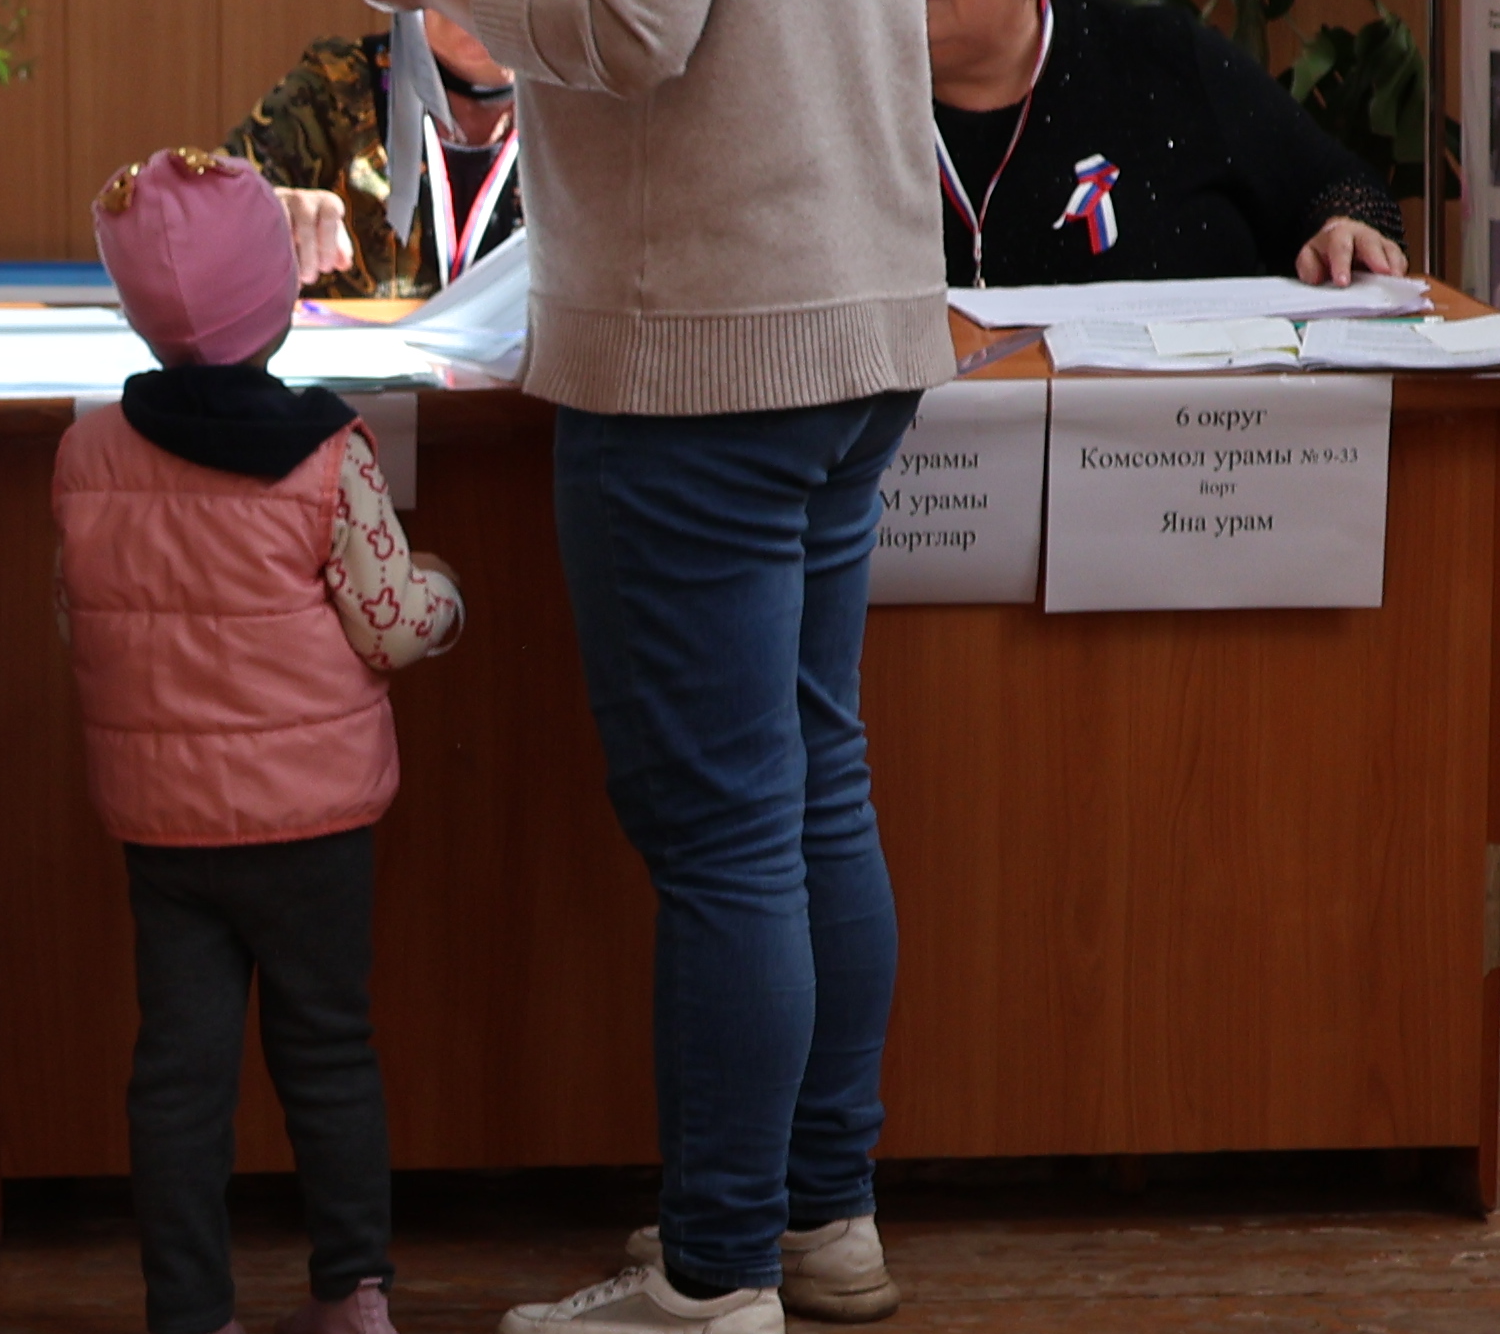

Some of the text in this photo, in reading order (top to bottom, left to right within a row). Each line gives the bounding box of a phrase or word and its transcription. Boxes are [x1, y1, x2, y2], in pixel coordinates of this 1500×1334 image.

[1176, 405, 1268, 434] 6 округ
[900, 452, 979, 476] урамы
[1080, 446, 1359, 475] Комсомол урамы № 9-33
[1199, 478, 1238, 499] йорт
[910, 493, 988, 516] урамы
[1215, 512, 1274, 539] урам
[879, 527, 976, 553] йортлар
